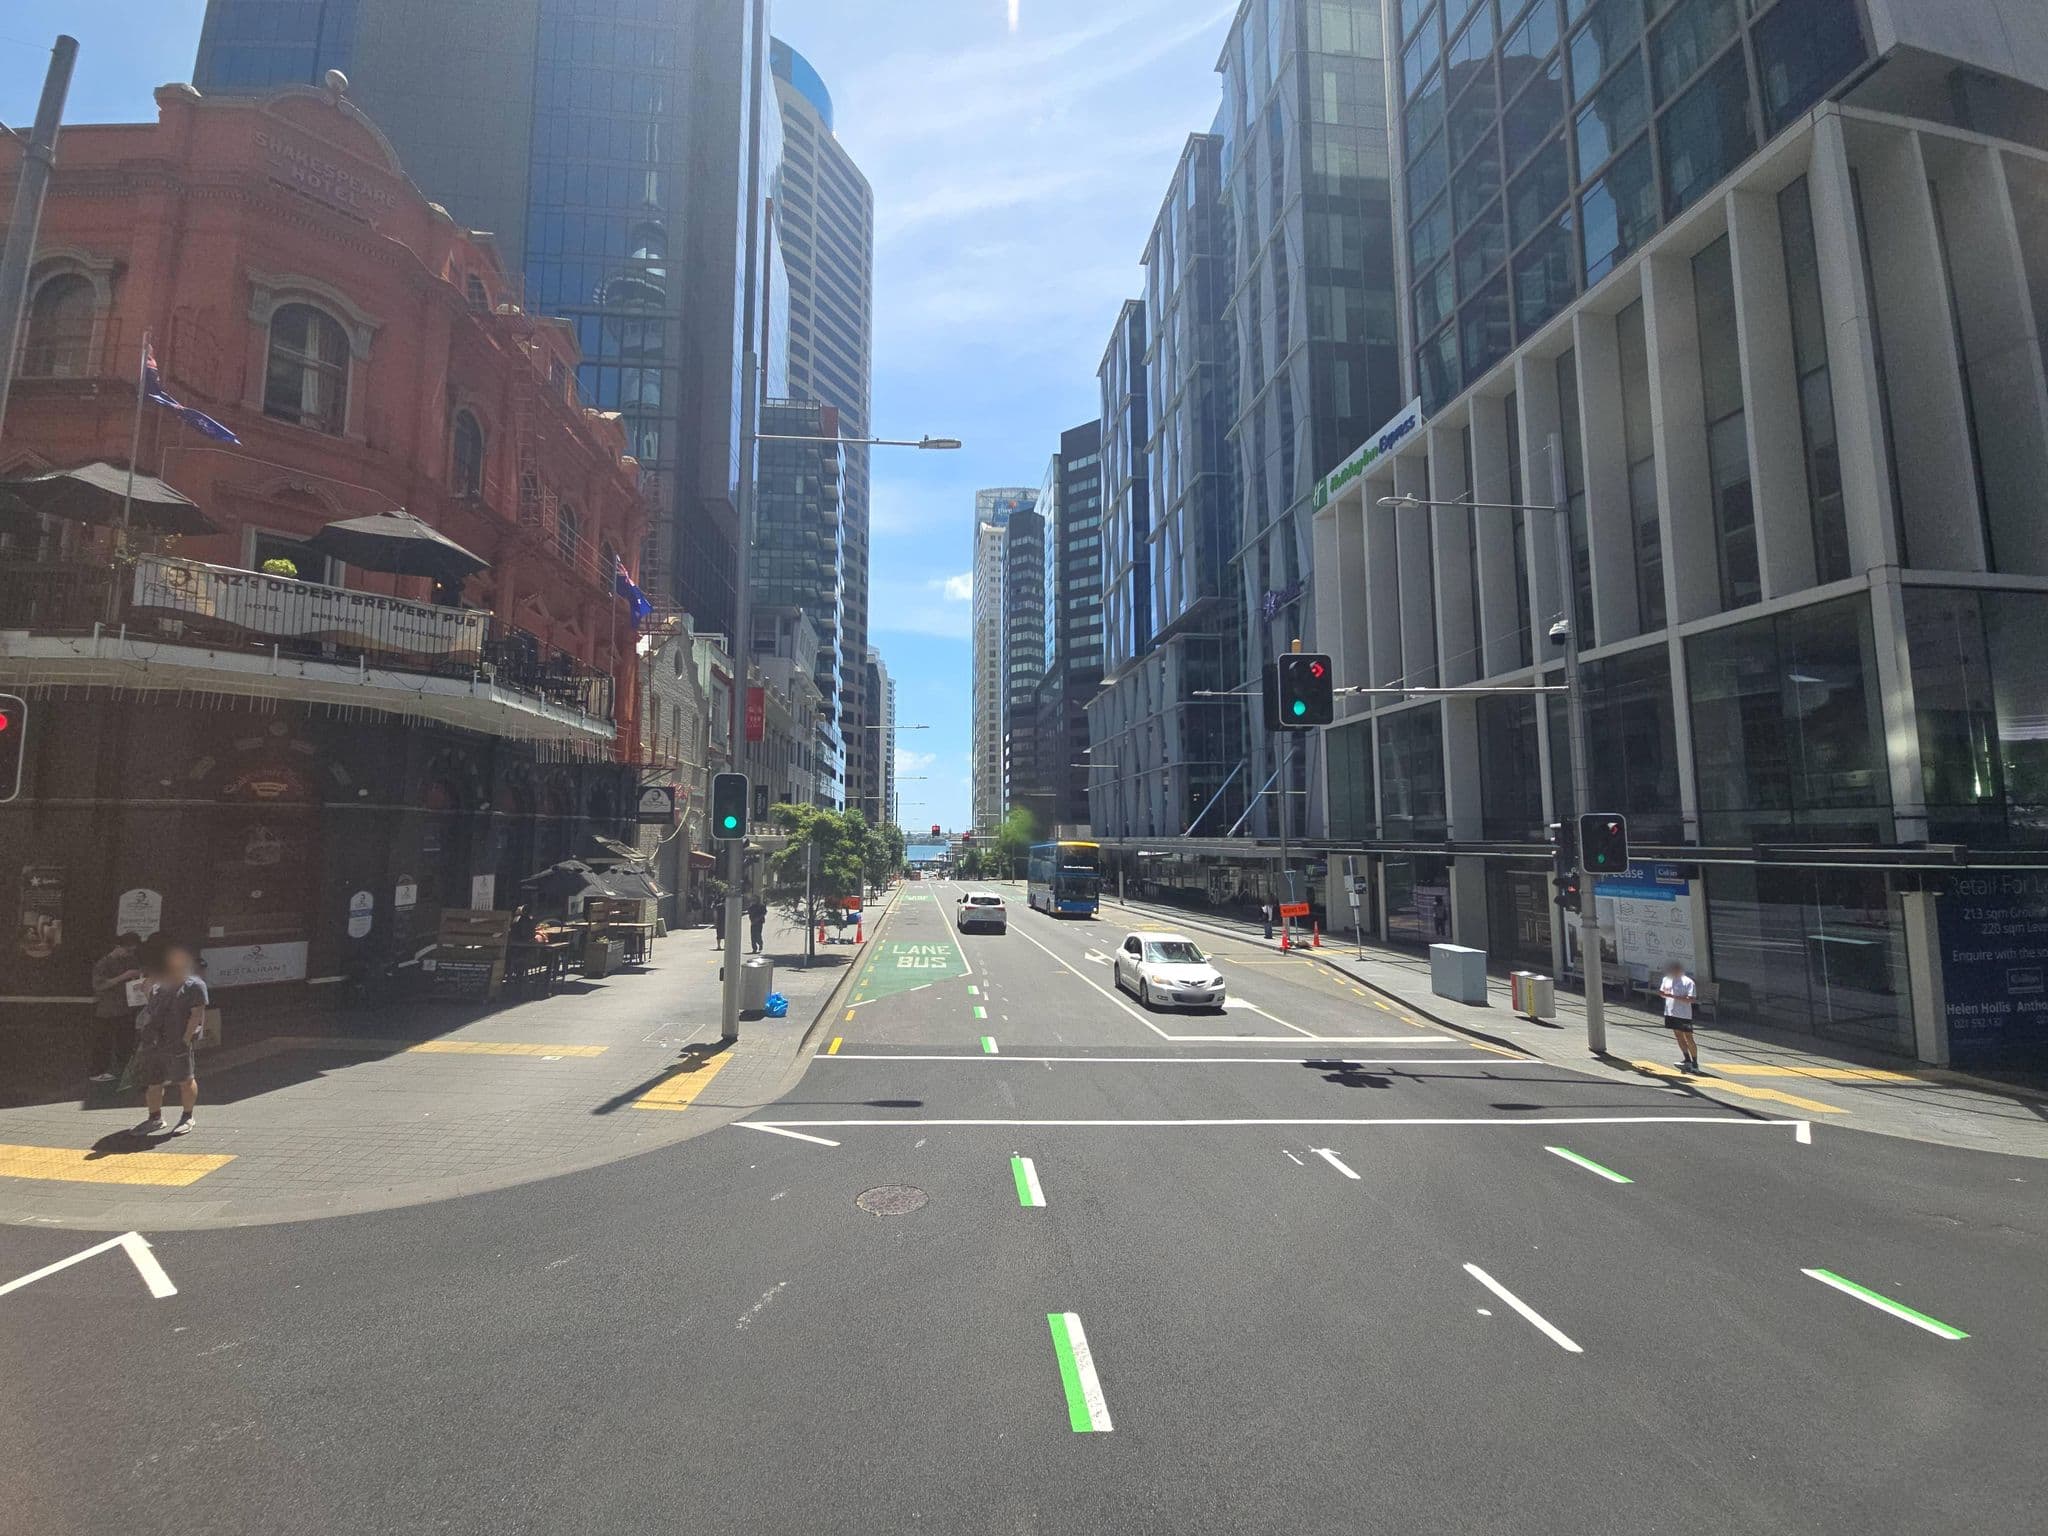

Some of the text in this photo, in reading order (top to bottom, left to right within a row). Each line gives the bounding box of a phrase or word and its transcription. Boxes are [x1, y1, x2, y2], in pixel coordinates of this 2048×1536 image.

[245, 603, 281, 613] HOTEL
[267, 579, 345, 603] OLDEST
[351, 595, 438, 620] BREWERY
[442, 614, 478, 628] PUB
[892, 945, 951, 955] LANE
[1953, 950, 1993, 963] Enquire
[1995, 949, 2017, 960] with
[897, 956, 947, 968] BUS
[1946, 1003, 1979, 1015] Helen
[1981, 1001, 2011, 1013] Hollis
